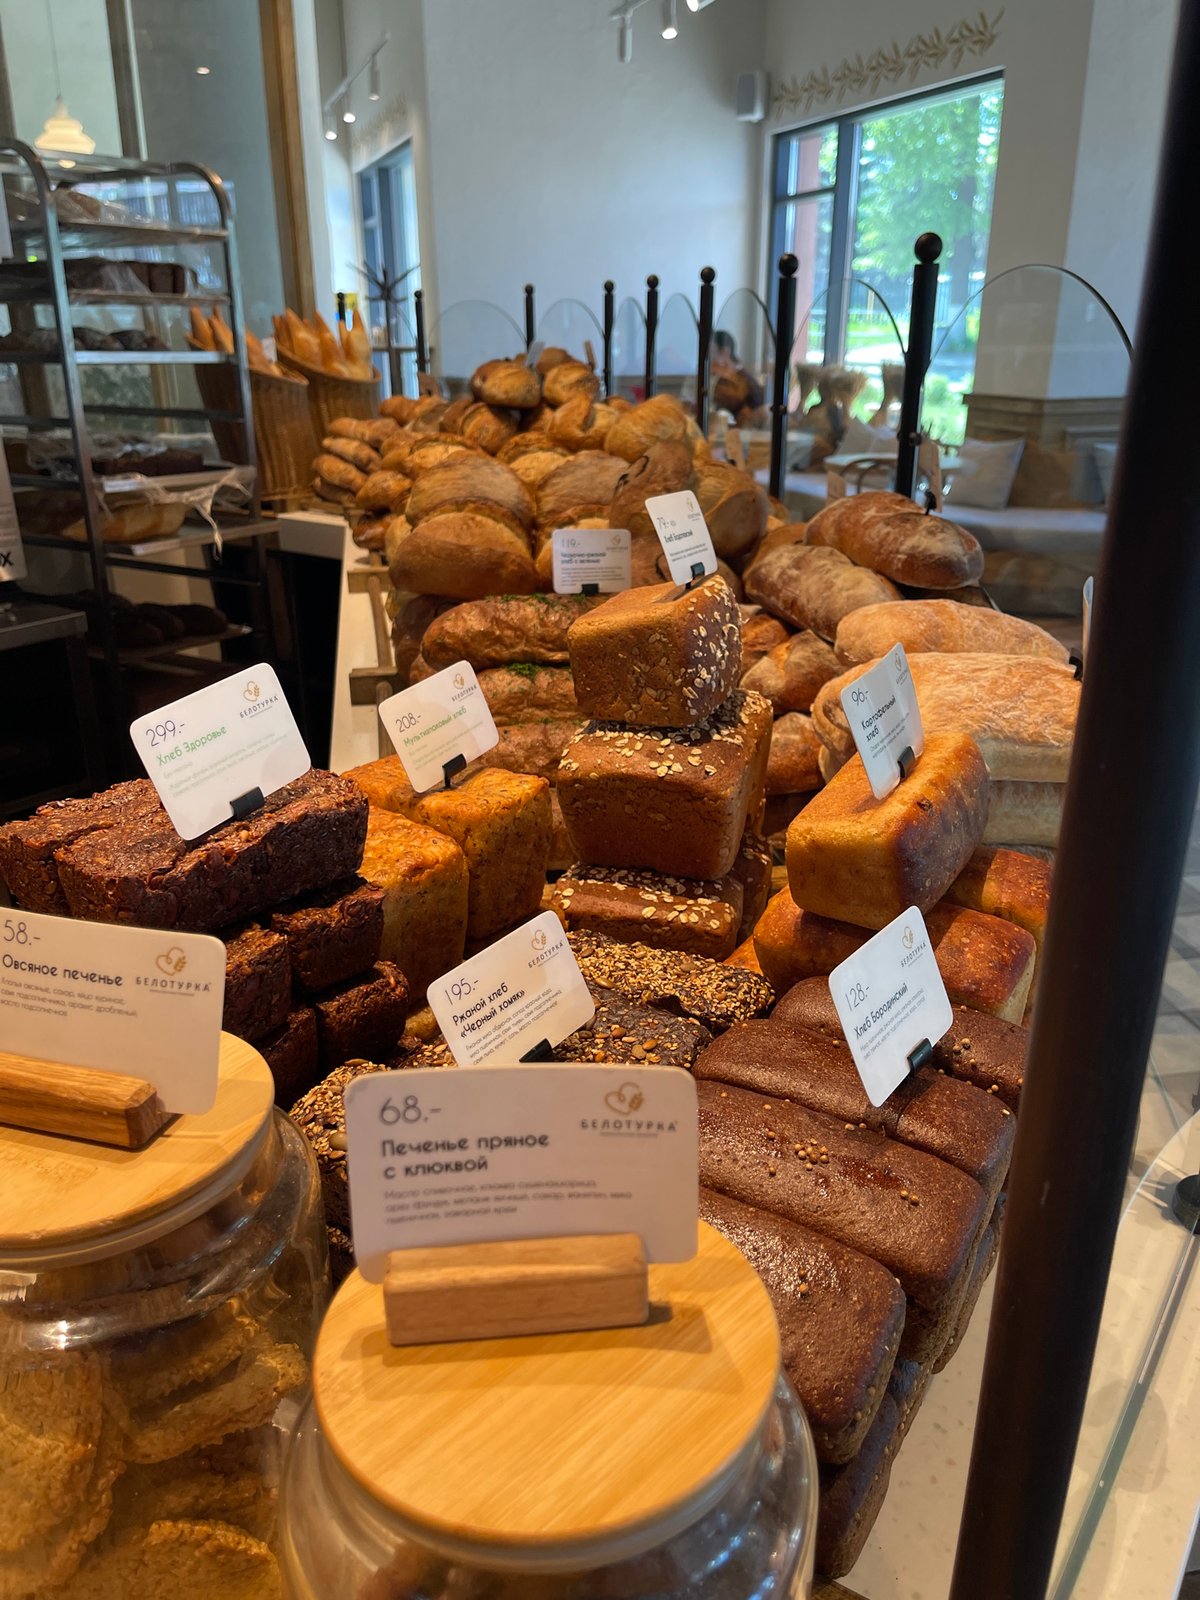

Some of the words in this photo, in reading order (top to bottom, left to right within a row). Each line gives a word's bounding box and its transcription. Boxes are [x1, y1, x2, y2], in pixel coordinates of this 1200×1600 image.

[239, 695, 280, 719] БЕЛОТУРКА
[851, 687, 870, 707] 96.-
[395, 712, 422, 733] 208.-
[861, 694, 897, 731] Картофельный
[145, 719, 186, 748] 299.-
[156, 744, 184, 767] Хлеб
[184, 725, 228, 753] Здоровье
[866, 726, 880, 743] хлеб
[3, 919, 42, 947] 58.-
[528, 940, 564, 968] БЕЛОТУРКА
[2, 954, 59, 977] Овсяное
[63, 968, 124, 987] печенье
[135, 976, 211, 993] БЕЛОТУРКА
[444, 977, 480, 1006] 195.-
[452, 998, 487, 1026] Ржаной
[488, 982, 509, 1004] хлеб
[843, 982, 870, 1012] 128.-
[460, 1007, 498, 1038] «Черный
[498, 989, 526, 1012] хомяк»
[853, 1015, 872, 1040] Хлеб
[870, 982, 910, 1025] Бородинский
[379, 1095, 442, 1126] 68.-
[580, 1118, 679, 1133] БЕЛОТУРКА
[381, 1135, 470, 1158] Печенье
[477, 1133, 550, 1150] пряное
[383, 1166, 396, 1180] с
[404, 1156, 489, 1178] клюквой
